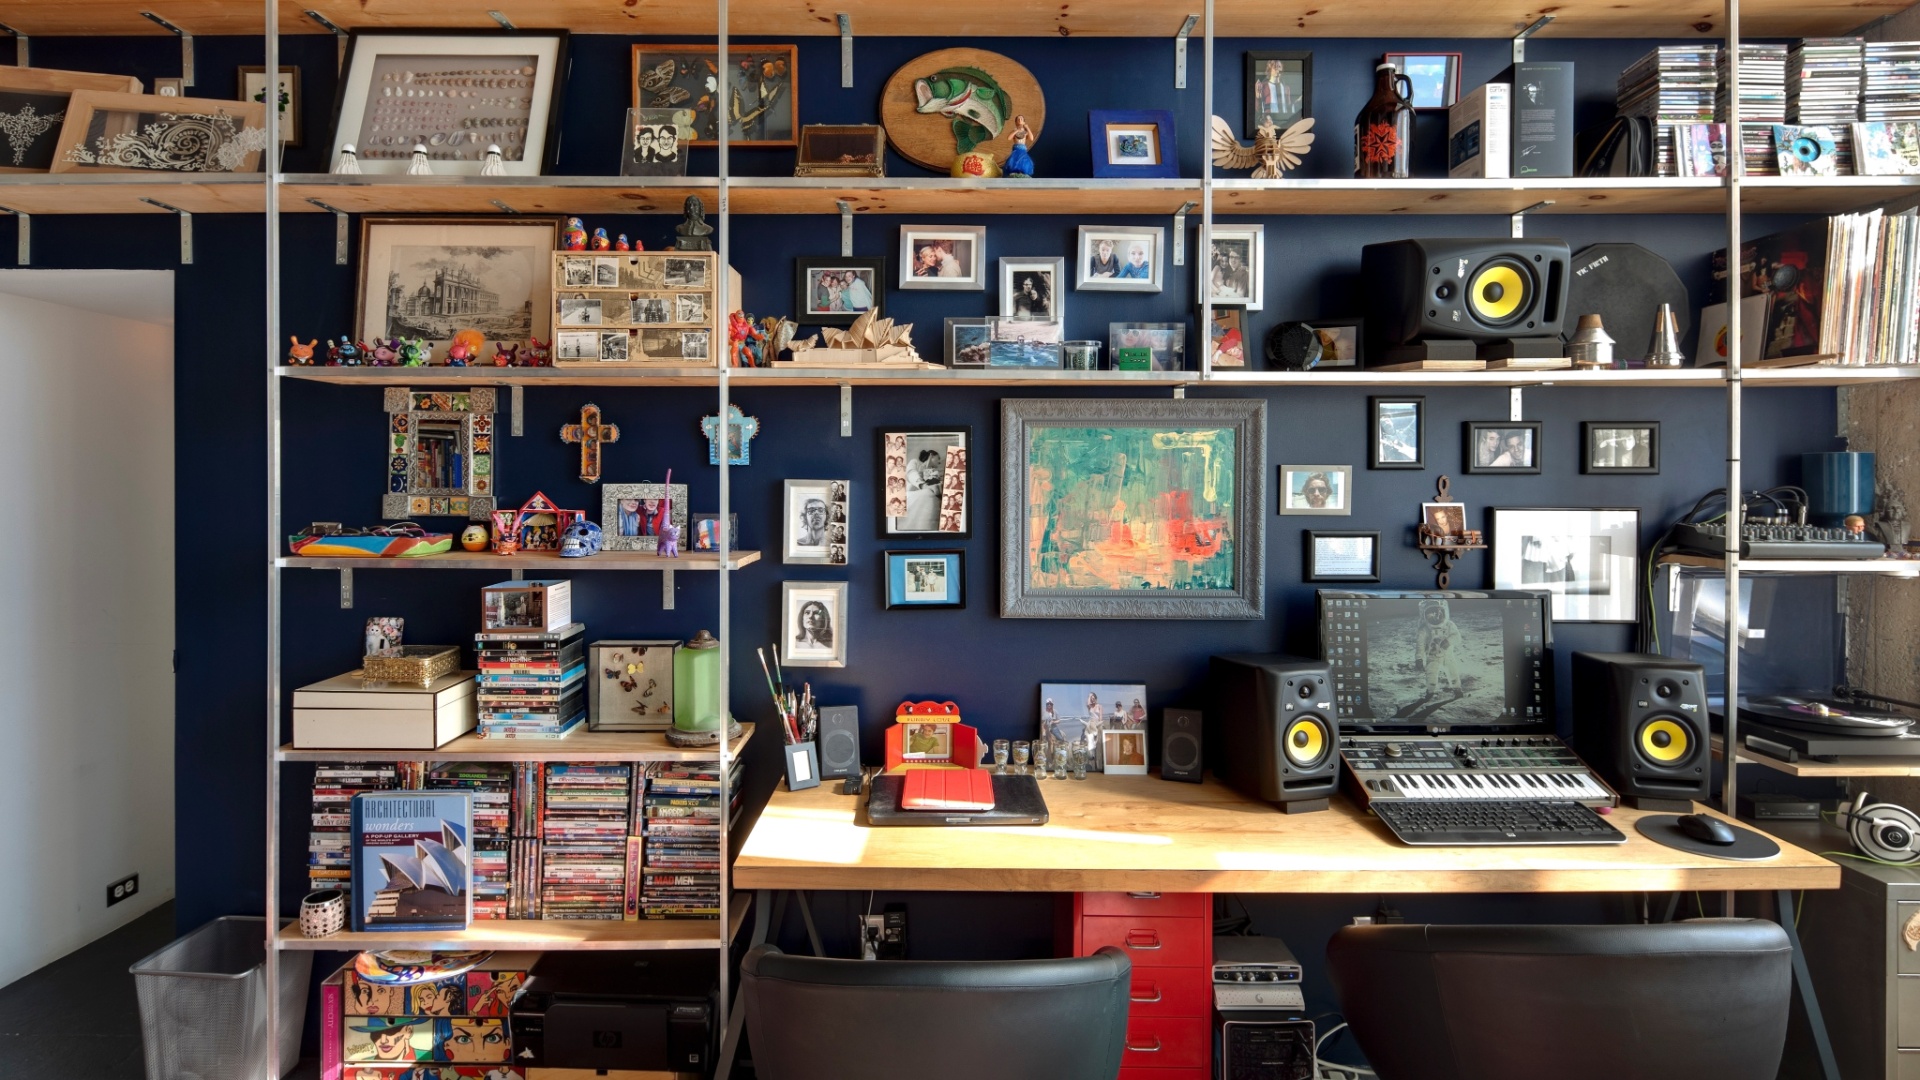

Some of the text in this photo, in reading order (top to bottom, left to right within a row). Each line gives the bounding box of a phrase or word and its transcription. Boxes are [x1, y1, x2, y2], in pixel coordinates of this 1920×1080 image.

[1576, 255, 1608, 276] VIC FIRTH
[365, 800, 436, 818] ARCHITECTURAL
[366, 818, 414, 831] wonders
[654, 876, 694, 885] MAD MEN
[469, 985, 481, 997] NO
